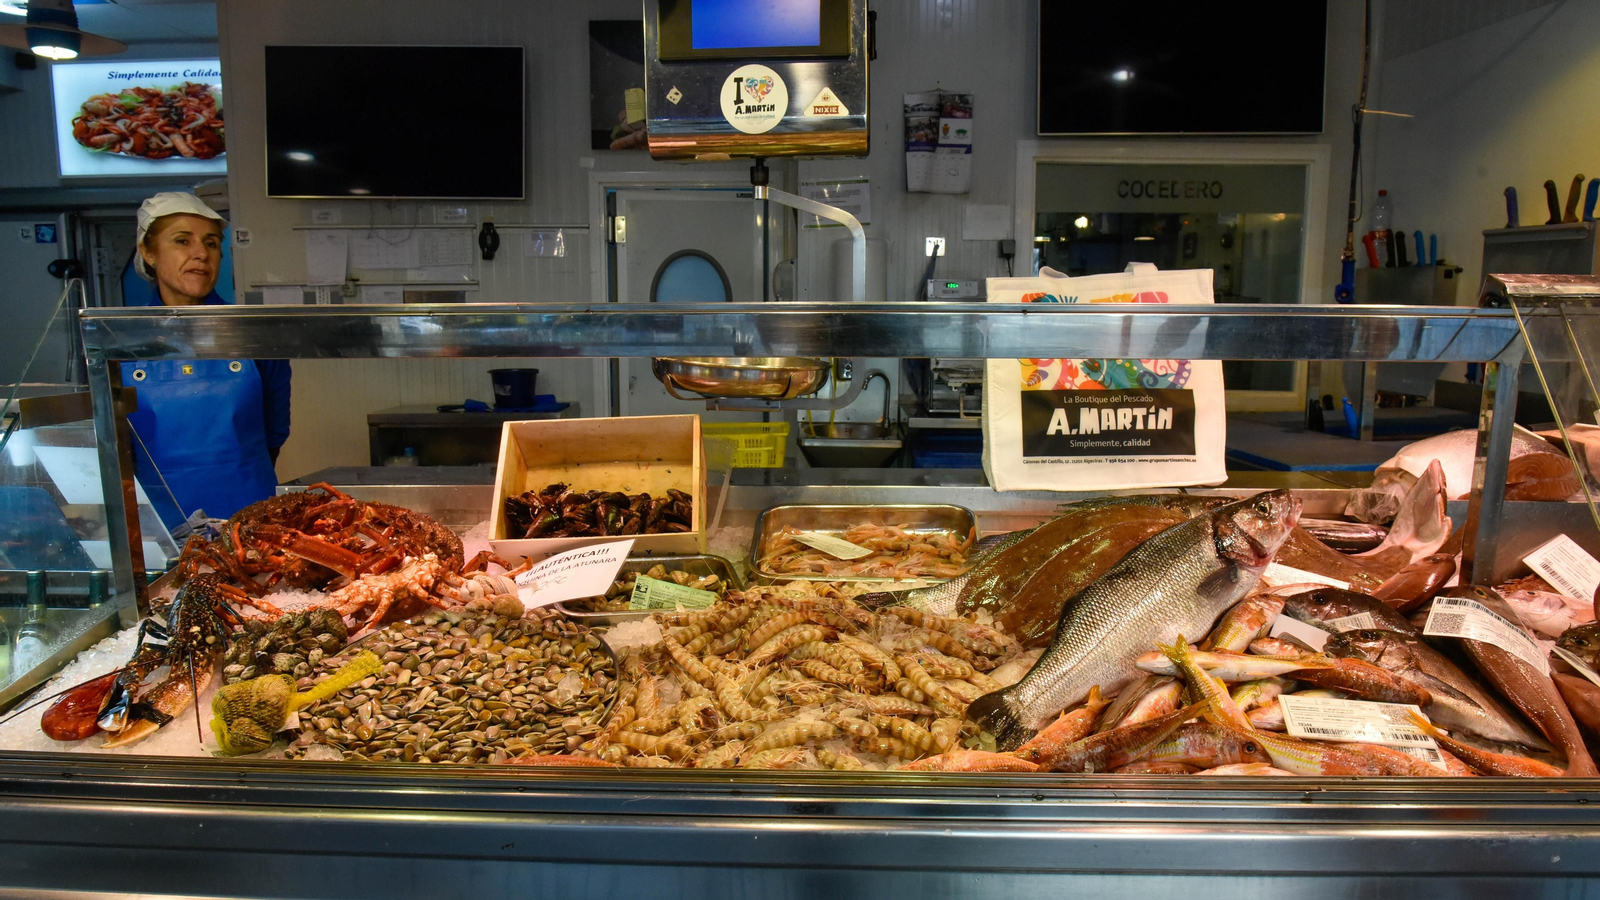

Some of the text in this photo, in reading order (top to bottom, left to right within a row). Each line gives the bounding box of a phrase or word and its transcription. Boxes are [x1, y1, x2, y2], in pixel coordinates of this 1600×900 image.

[107, 70, 178, 80] Simplemente
[733, 77, 744, 105] I
[814, 106, 838, 114] NIXIE
[1064, 394, 1154, 405] La Boutique del Pescado
[1069, 438, 1151, 449] Simplemente, calidad
[517, 557, 617, 587] OQUINA DE LA ATUNARA
